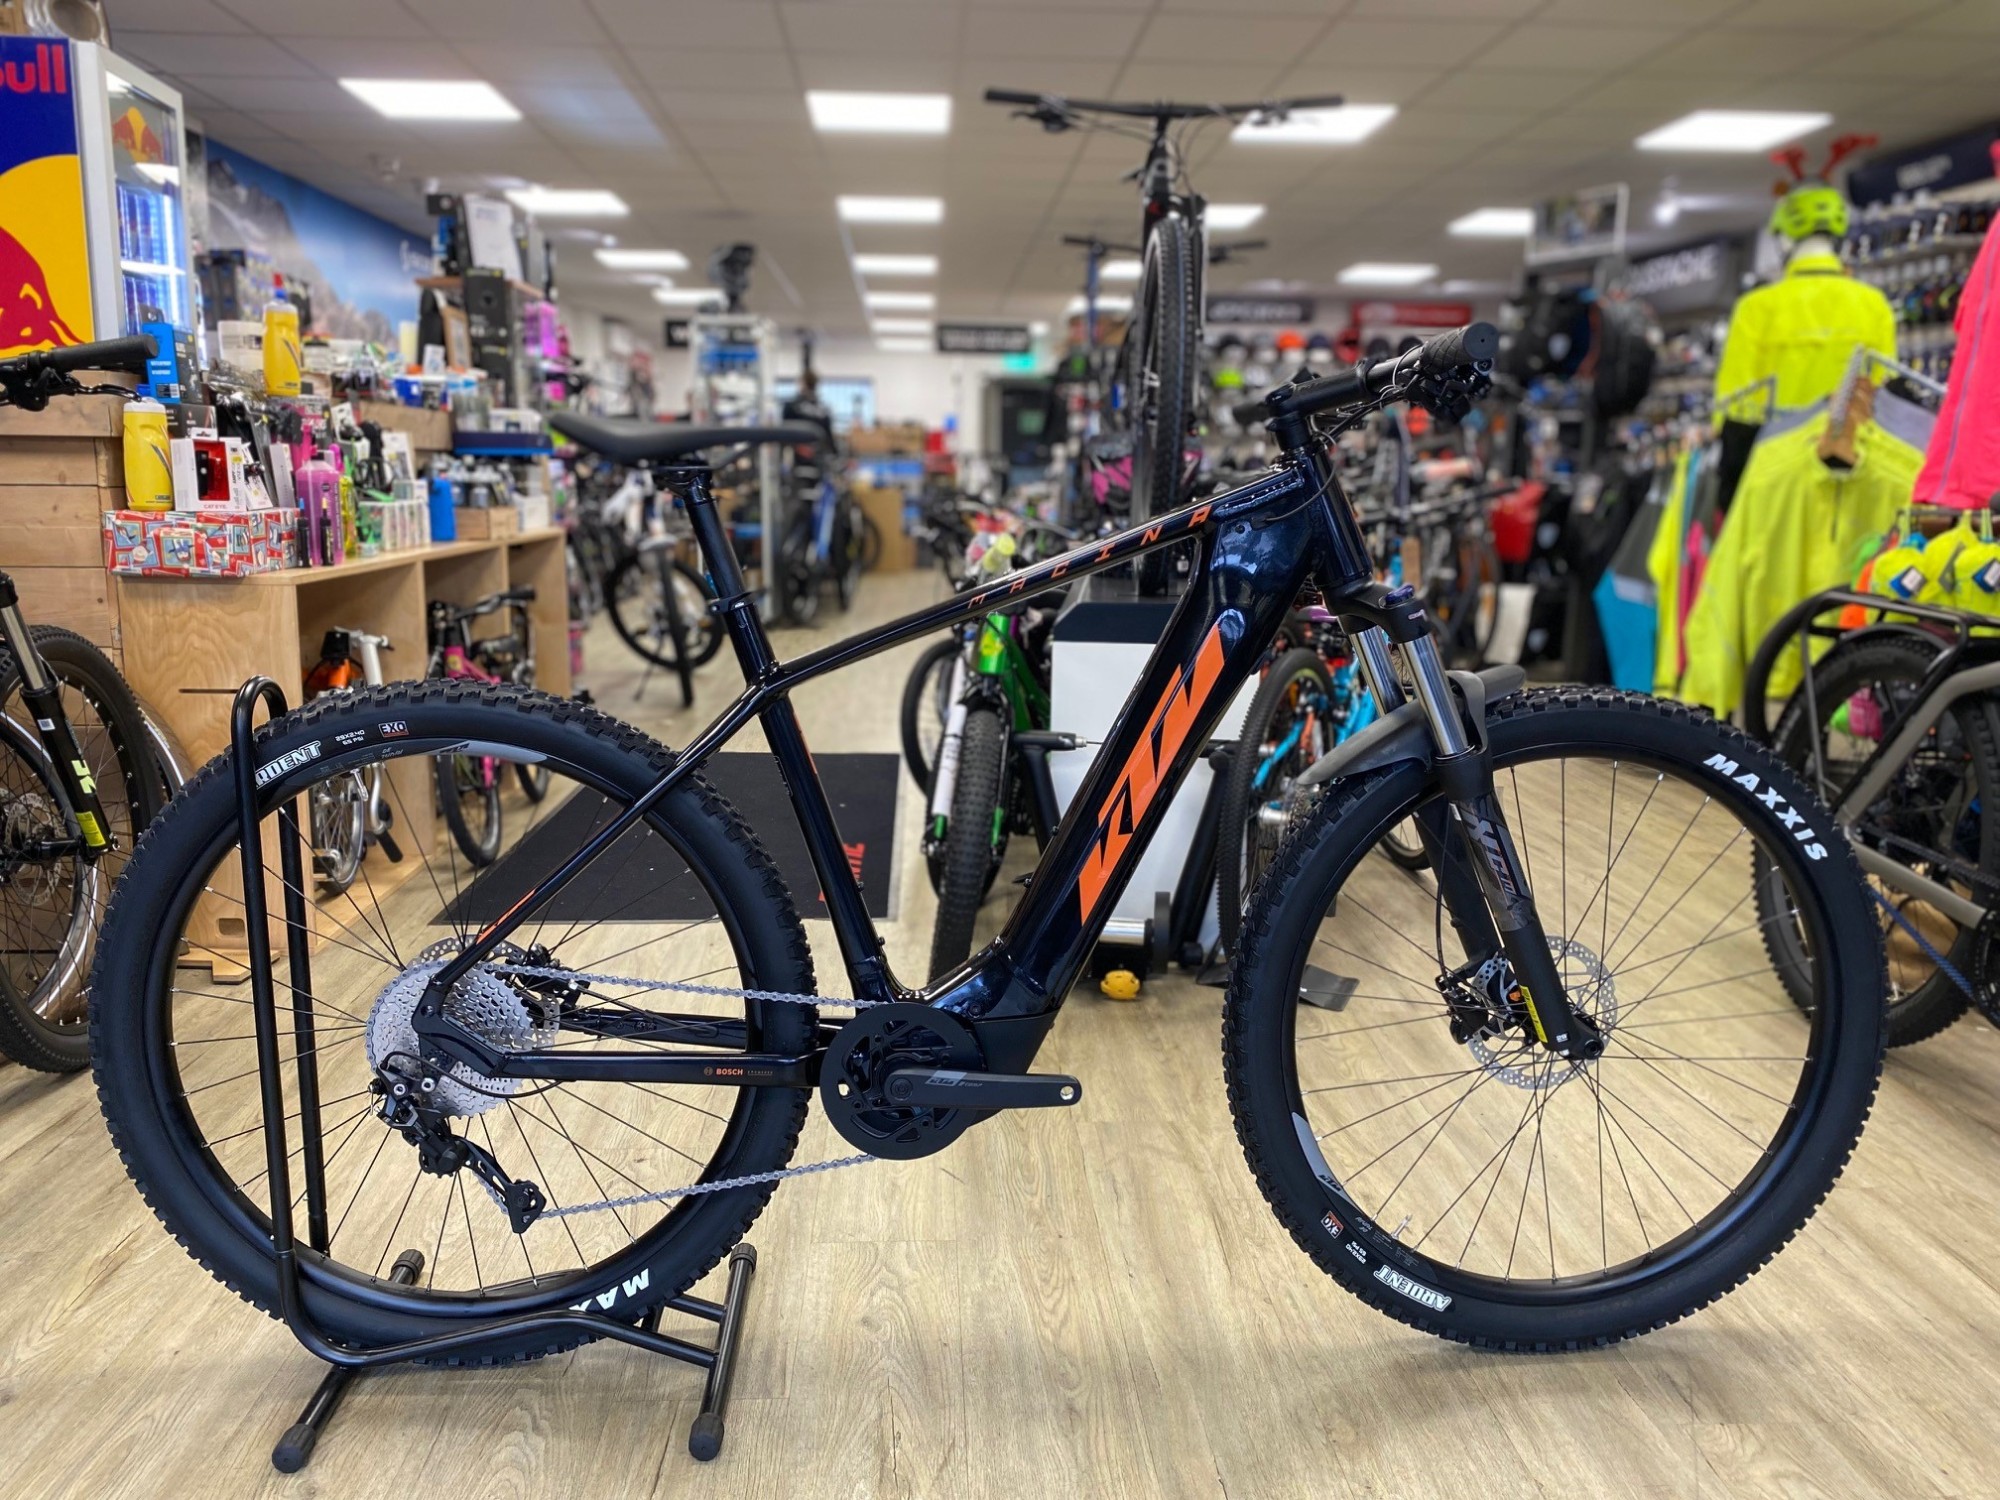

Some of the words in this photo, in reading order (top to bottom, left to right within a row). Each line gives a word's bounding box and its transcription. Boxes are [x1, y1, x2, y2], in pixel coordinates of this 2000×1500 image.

[0, 43, 67, 93] ull
[967, 504, 1212, 609] MACINA
[380, 721, 406, 734] EXO
[255, 740, 321, 790] RDENT
[1079, 624, 1224, 926] KTM
[1703, 753, 1828, 860] MAXXIS
[716, 1067, 744, 1076] BOSCH
[1322, 1214, 1341, 1239] EXO
[1373, 1264, 1452, 1312] ARDENT
